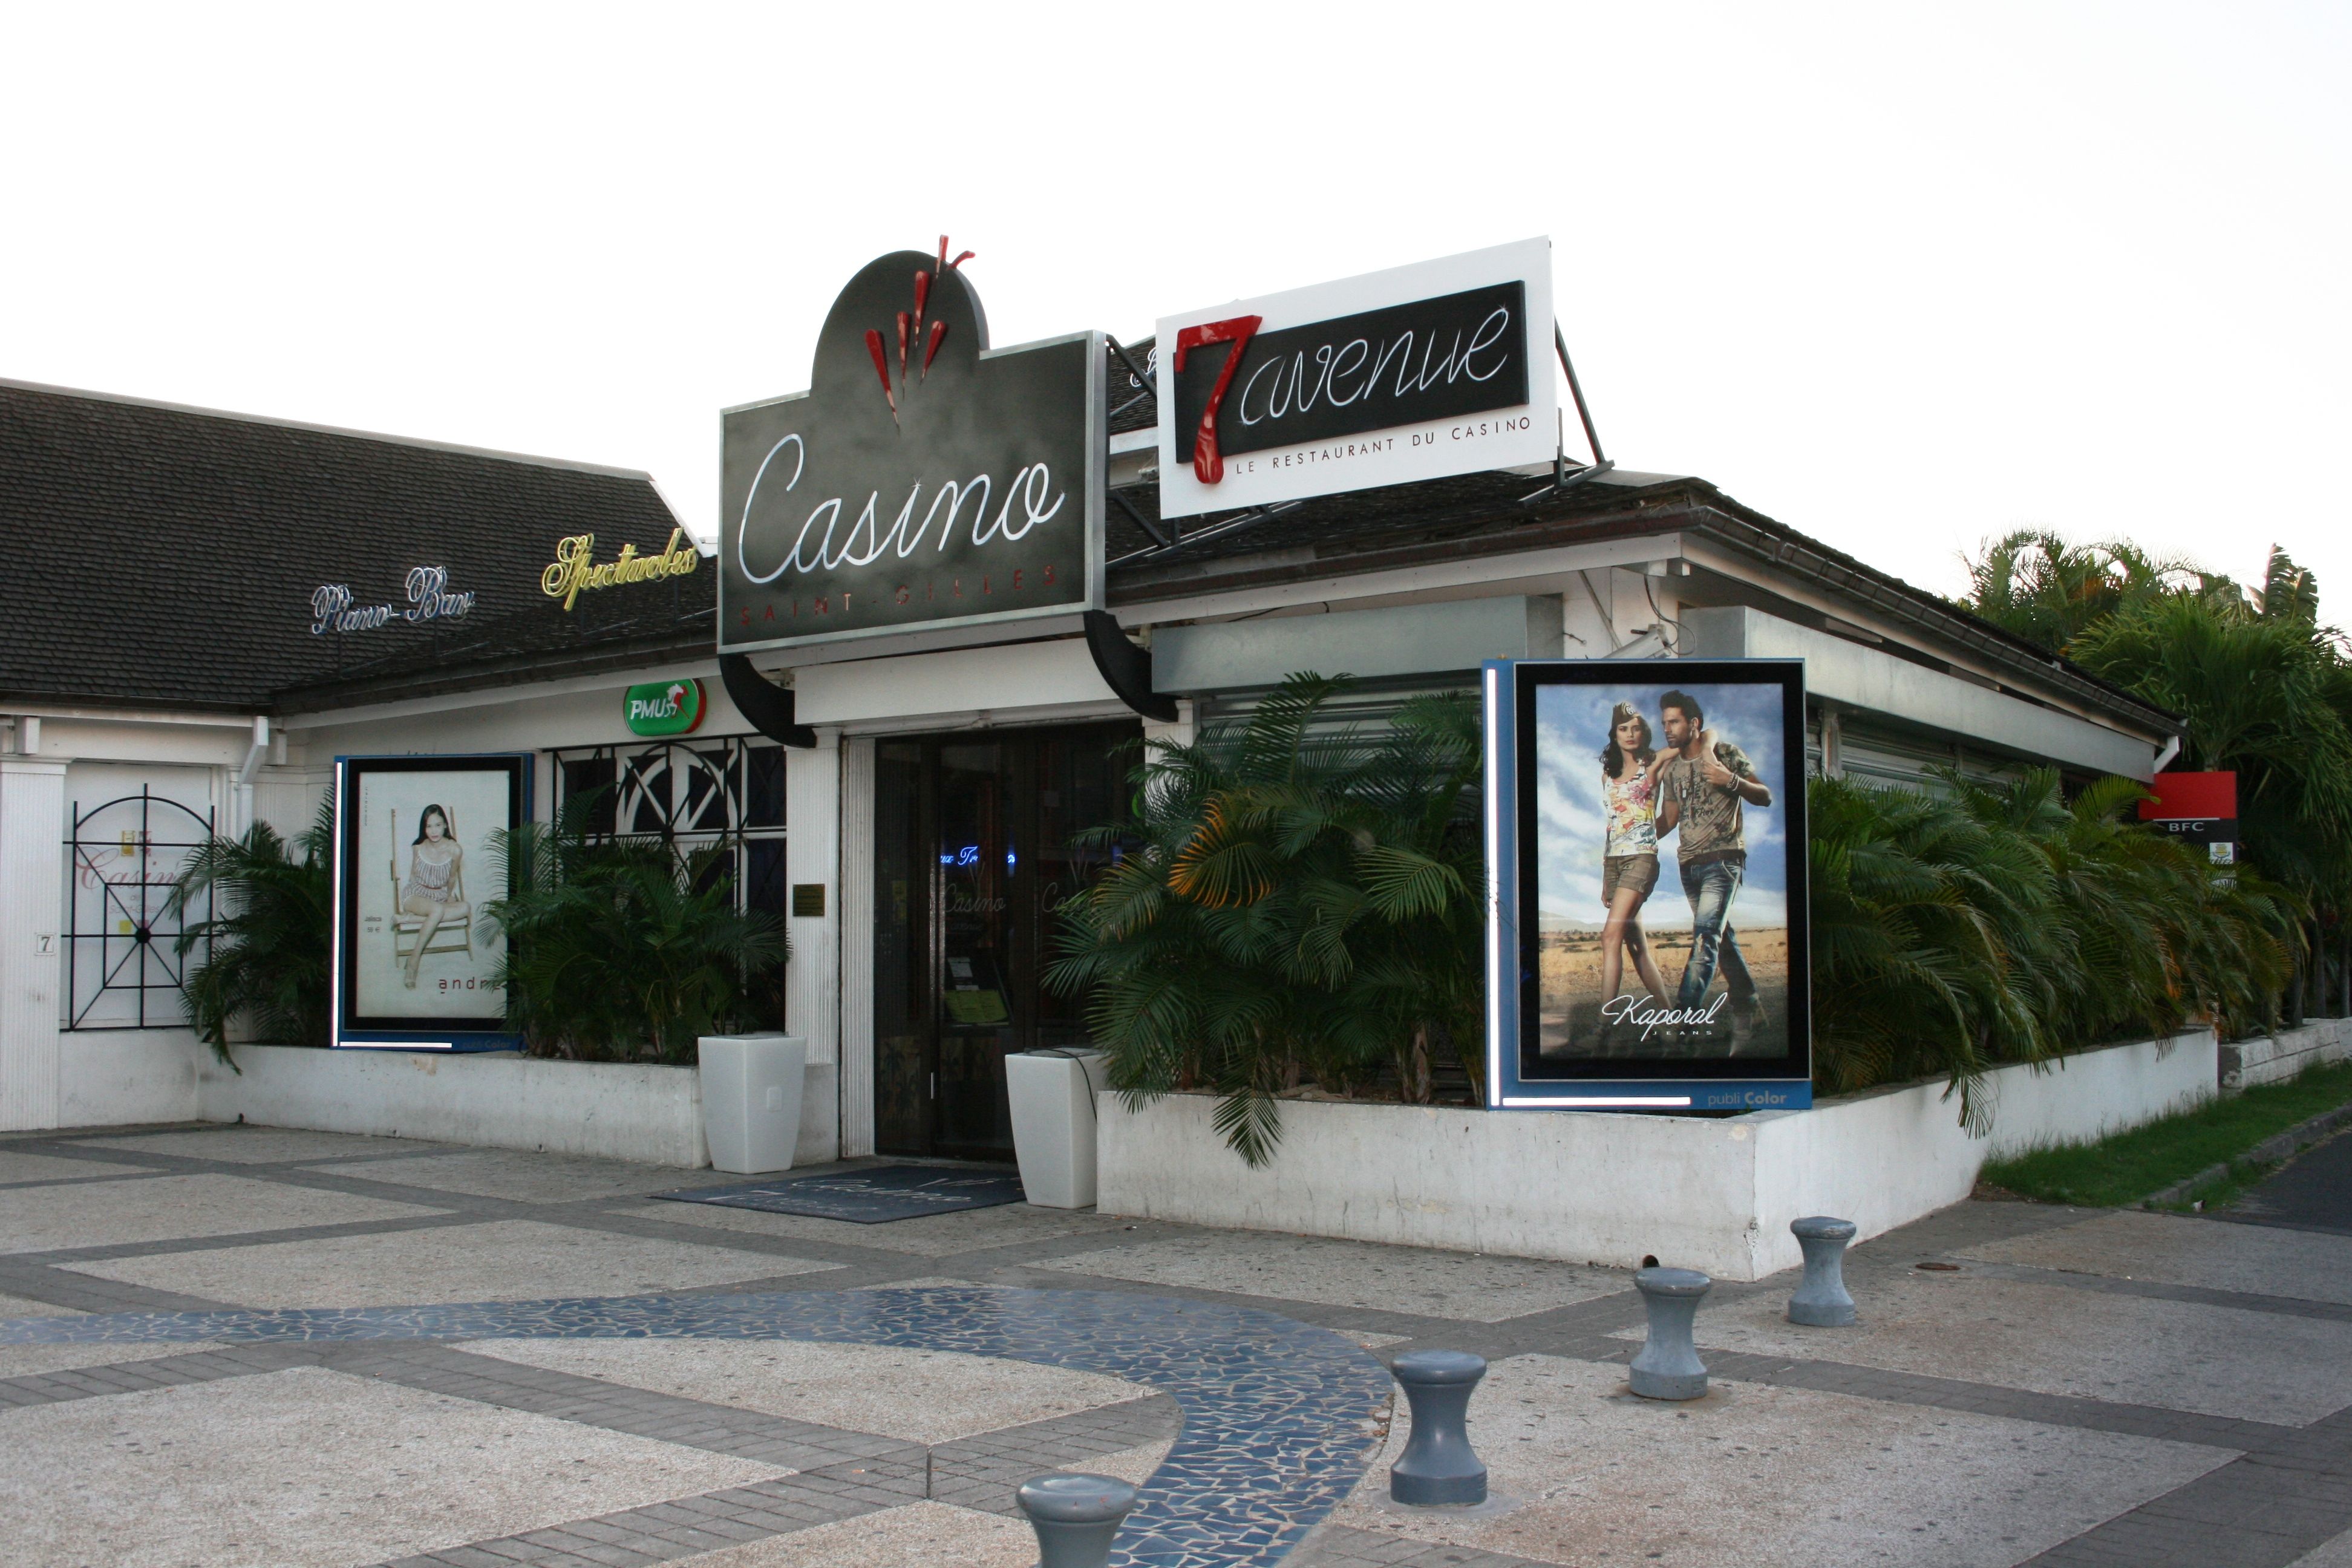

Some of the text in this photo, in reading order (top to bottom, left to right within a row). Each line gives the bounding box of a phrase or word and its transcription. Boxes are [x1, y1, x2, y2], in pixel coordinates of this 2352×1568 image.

[1240, 307, 1509, 425] avenue
[1236, 417, 1530, 474] LE RESTAURANT DU CASINO
[739, 433, 1065, 584] Casino
[630, 698, 666, 720] PMU
[2169, 822, 2204, 832] BFC
[75, 846, 181, 890] Casin
[944, 883, 1006, 913] Casino
[41, 936, 51, 952] 7
[439, 976, 500, 993] andr
[1602, 991, 1728, 1042] Kaporal
[1708, 1090, 1787, 1107] publi Color
